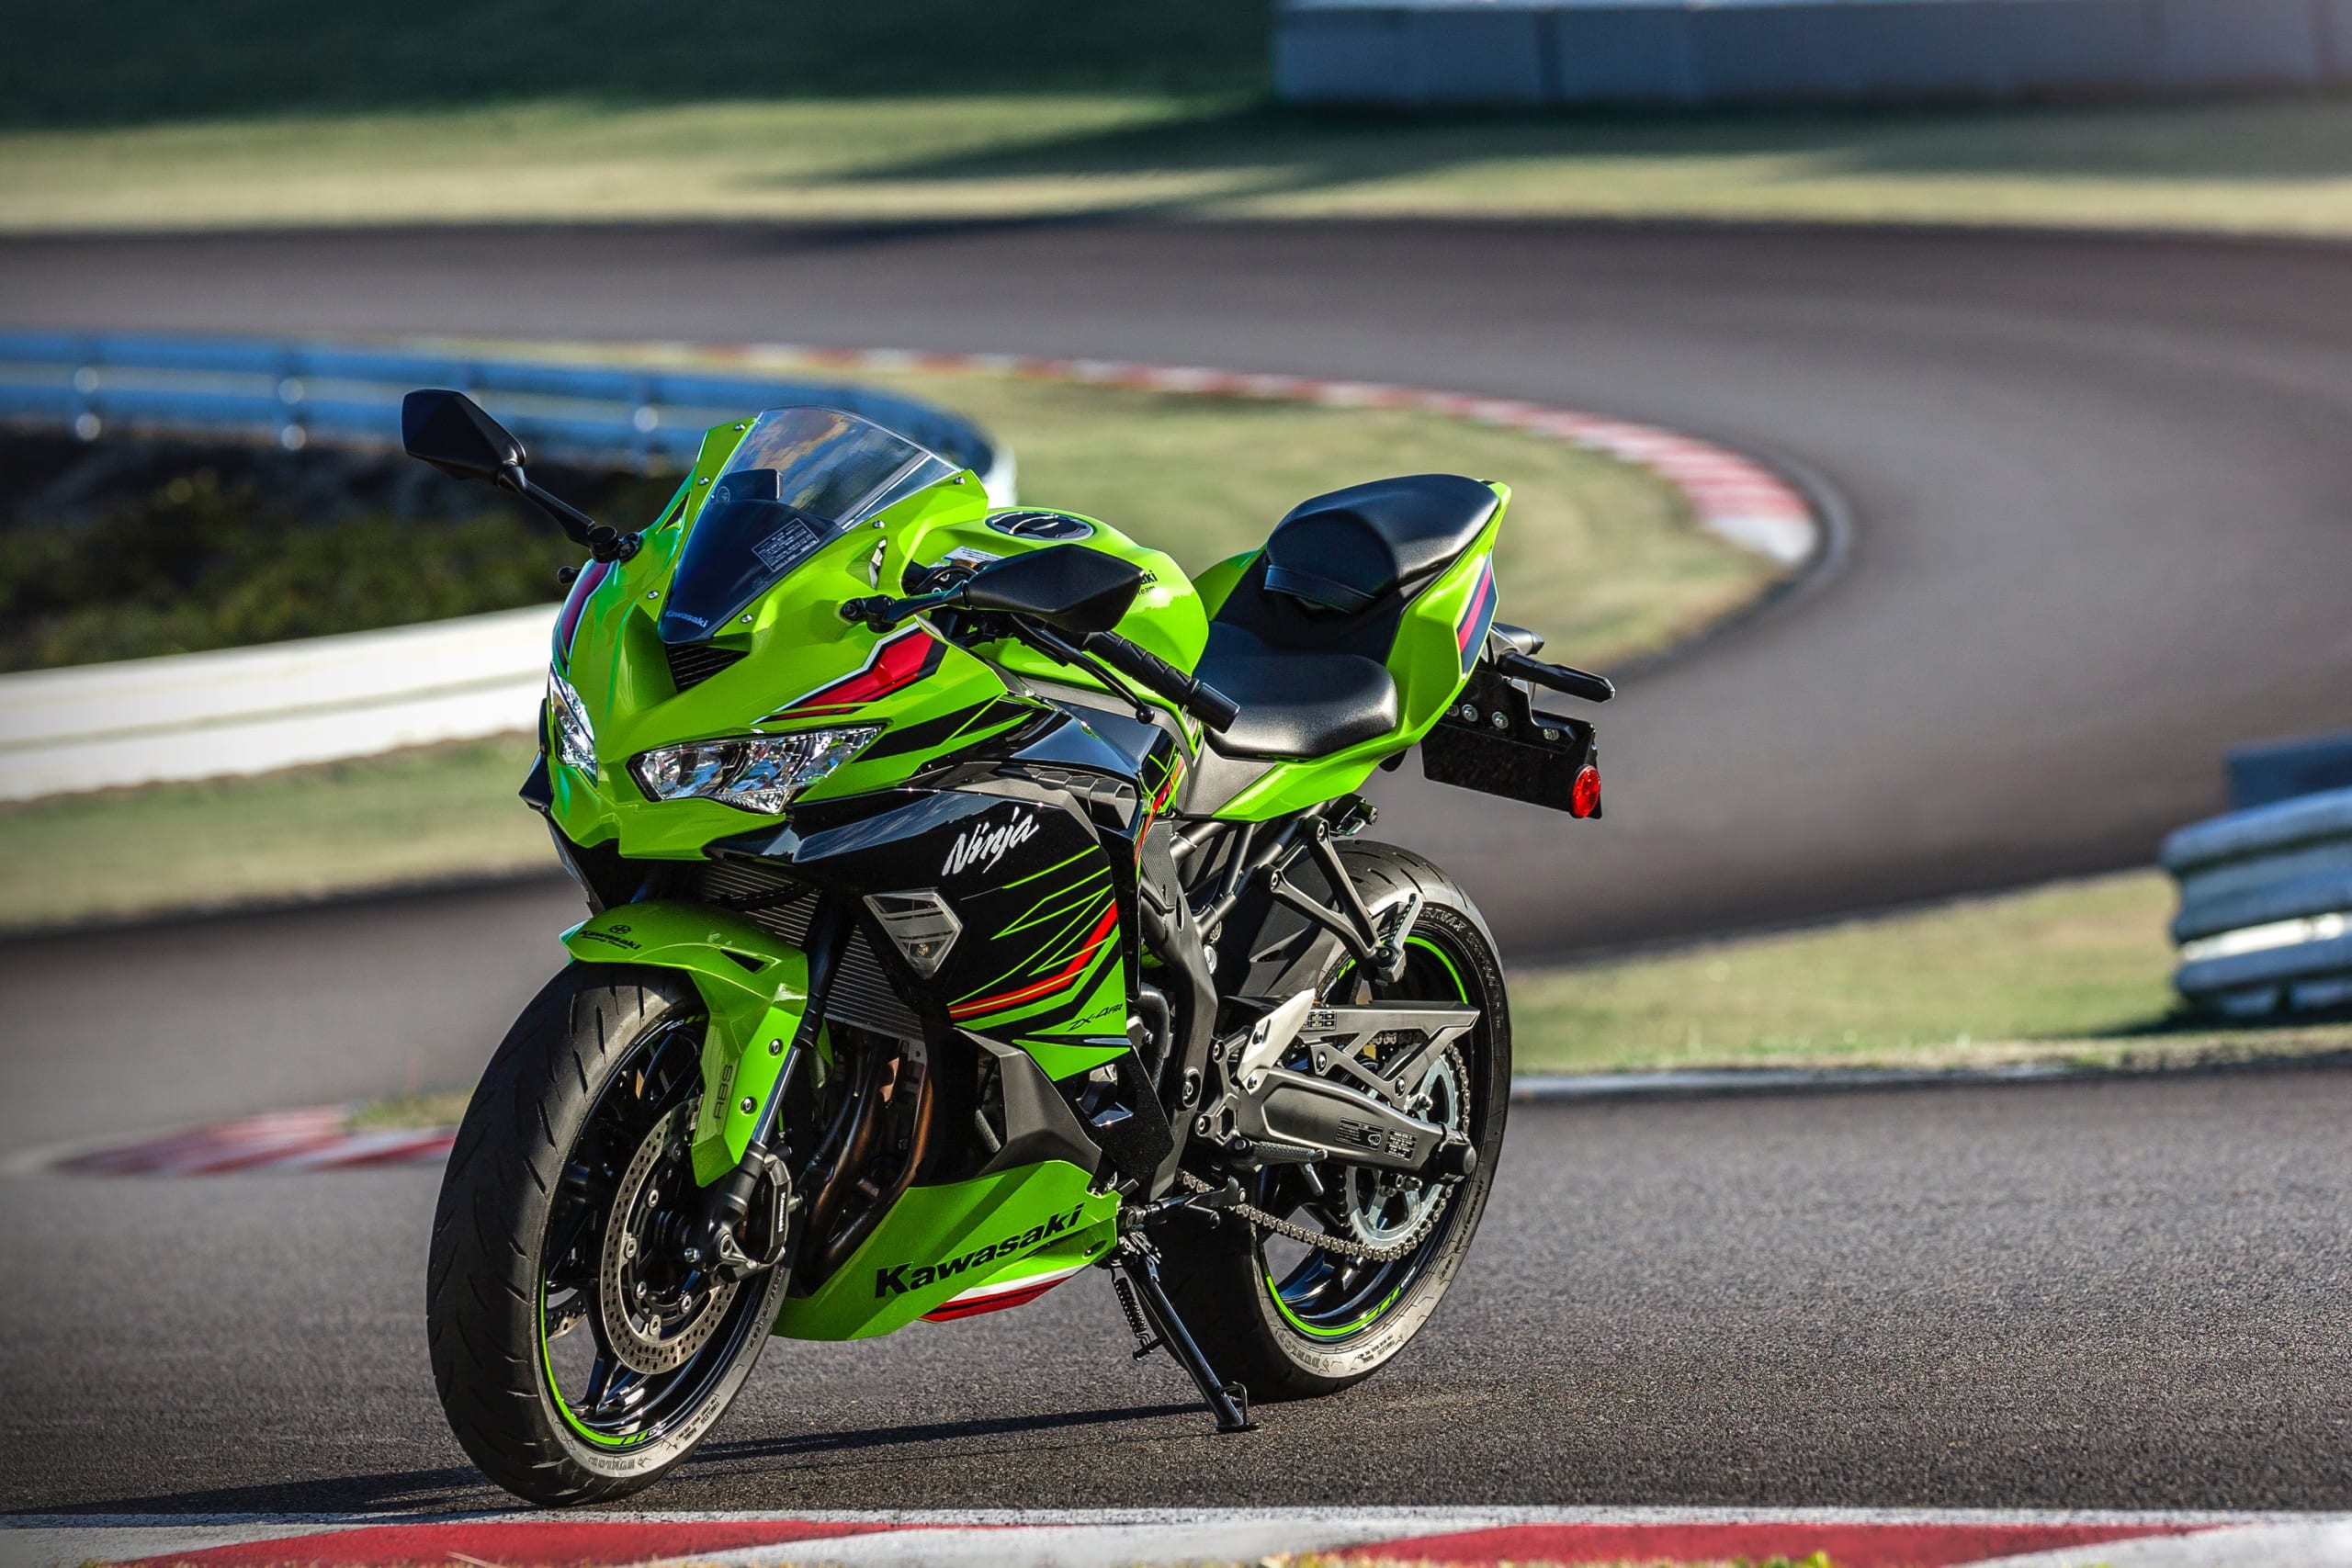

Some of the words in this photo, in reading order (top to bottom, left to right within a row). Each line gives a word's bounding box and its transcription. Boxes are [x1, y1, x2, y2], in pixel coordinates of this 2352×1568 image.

[942, 806, 1040, 876] Ninja
[579, 931, 642, 950] Kawasaki
[713, 1064, 733, 1120] ABS
[875, 1202, 1085, 1299] Kawasaki
